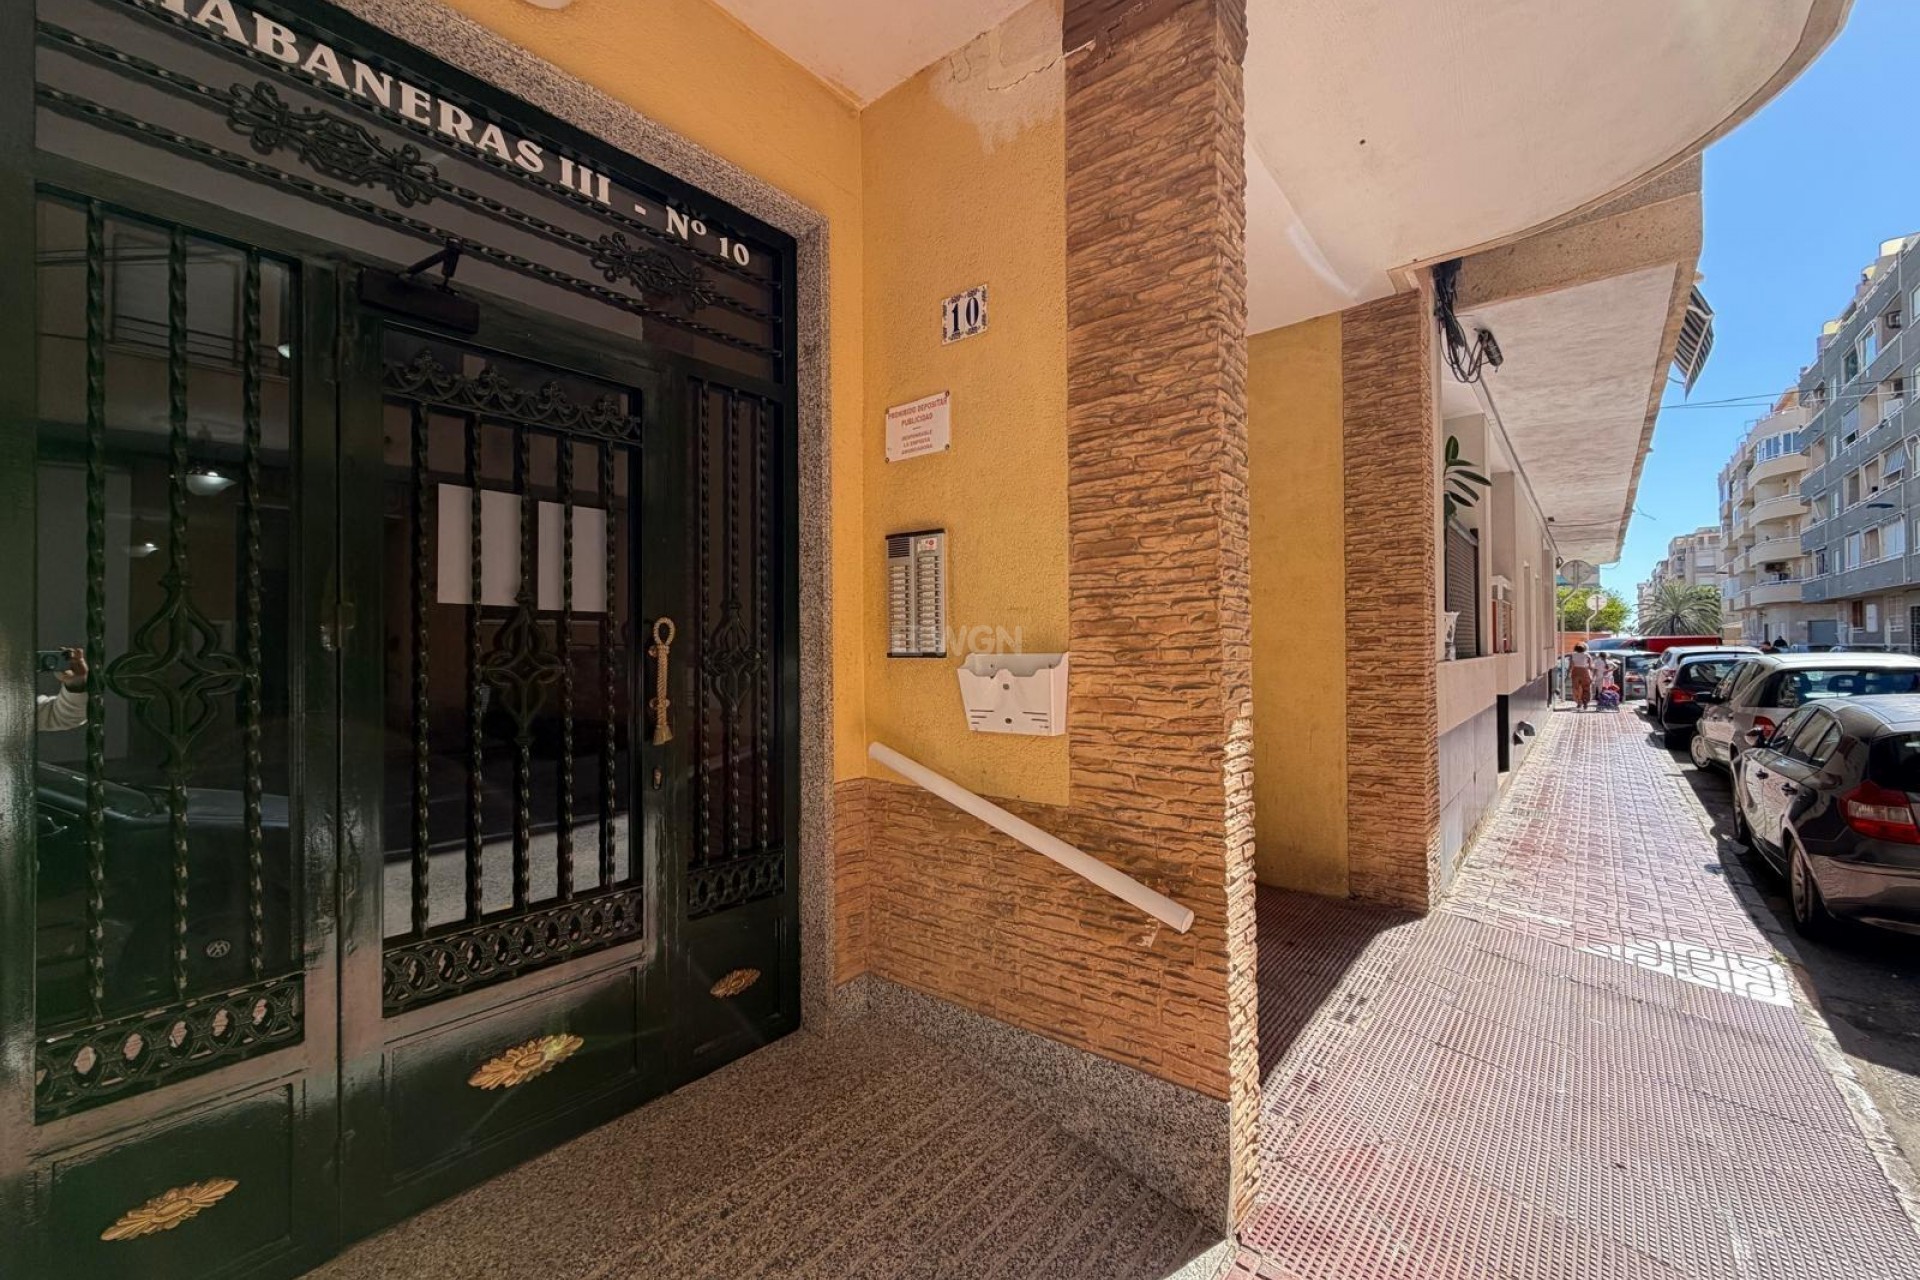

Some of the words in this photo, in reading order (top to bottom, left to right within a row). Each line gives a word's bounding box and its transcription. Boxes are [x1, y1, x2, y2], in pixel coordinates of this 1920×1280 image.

[559, 156, 611, 206] III
[719, 237, 750, 267] 10
[951, 297, 980, 333] 10
[917, 397, 948, 412] DEPOSITAR
[901, 412, 933, 428] PUBLICIDAD
